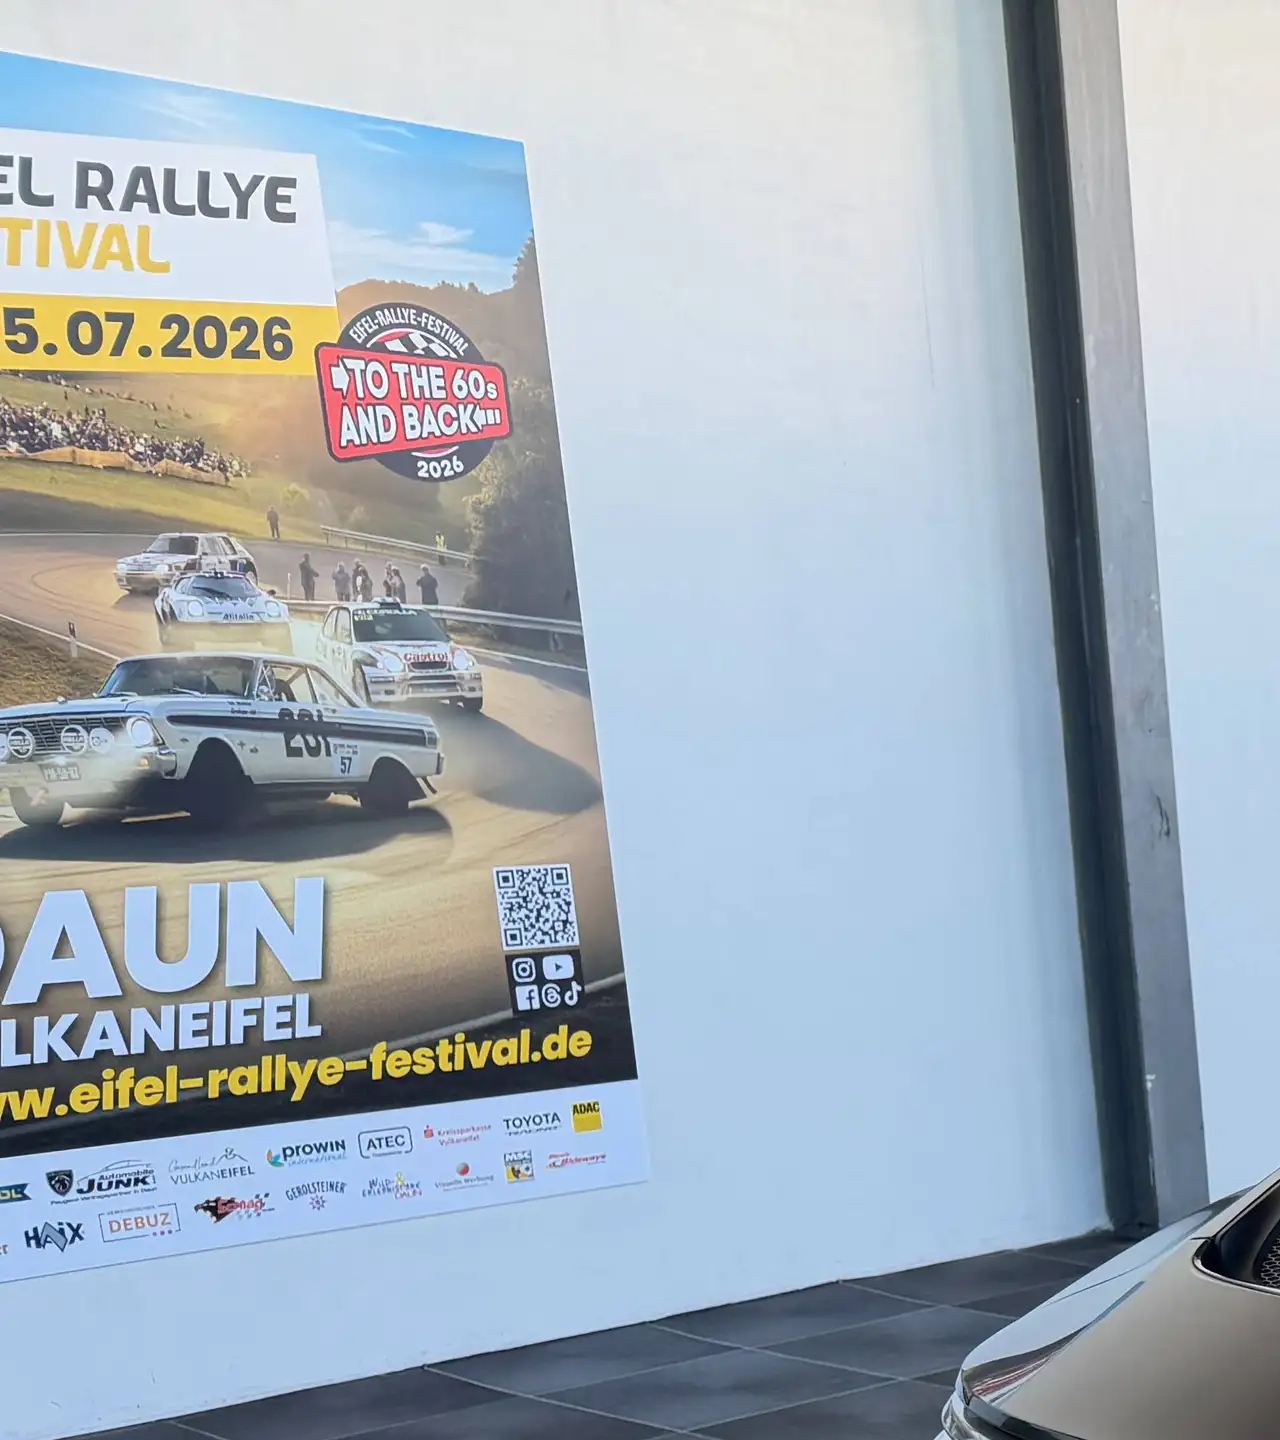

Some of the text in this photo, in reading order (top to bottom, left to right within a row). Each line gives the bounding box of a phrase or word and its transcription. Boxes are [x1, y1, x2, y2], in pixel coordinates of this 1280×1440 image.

[75, 161, 297, 224] RALLYE
[0, 217, 171, 274] TIVAL
[3, 307, 294, 360] 5.07.2026
[349, 307, 469, 357] EIFEL-RALLYE-FESTIVAL
[341, 358, 498, 400] TO THE 60s
[340, 404, 479, 448] AND BACK
[416, 455, 464, 479] 2026
[340, 756, 353, 775] 57
[0, 877, 325, 1006] AUN
[1, 993, 323, 1068] LKANEIFEL
[572, 1101, 600, 1116] ADAC
[503, 1112, 562, 1131] TOYOTA
[366, 1134, 406, 1151] ATEC
[76, 1176, 150, 1195] JUNK
[170, 1165, 255, 1186] VULKANEIFEL
[285, 1181, 347, 1201] GEROLSTEINER
[108, 1212, 172, 1234] DEBUZ
